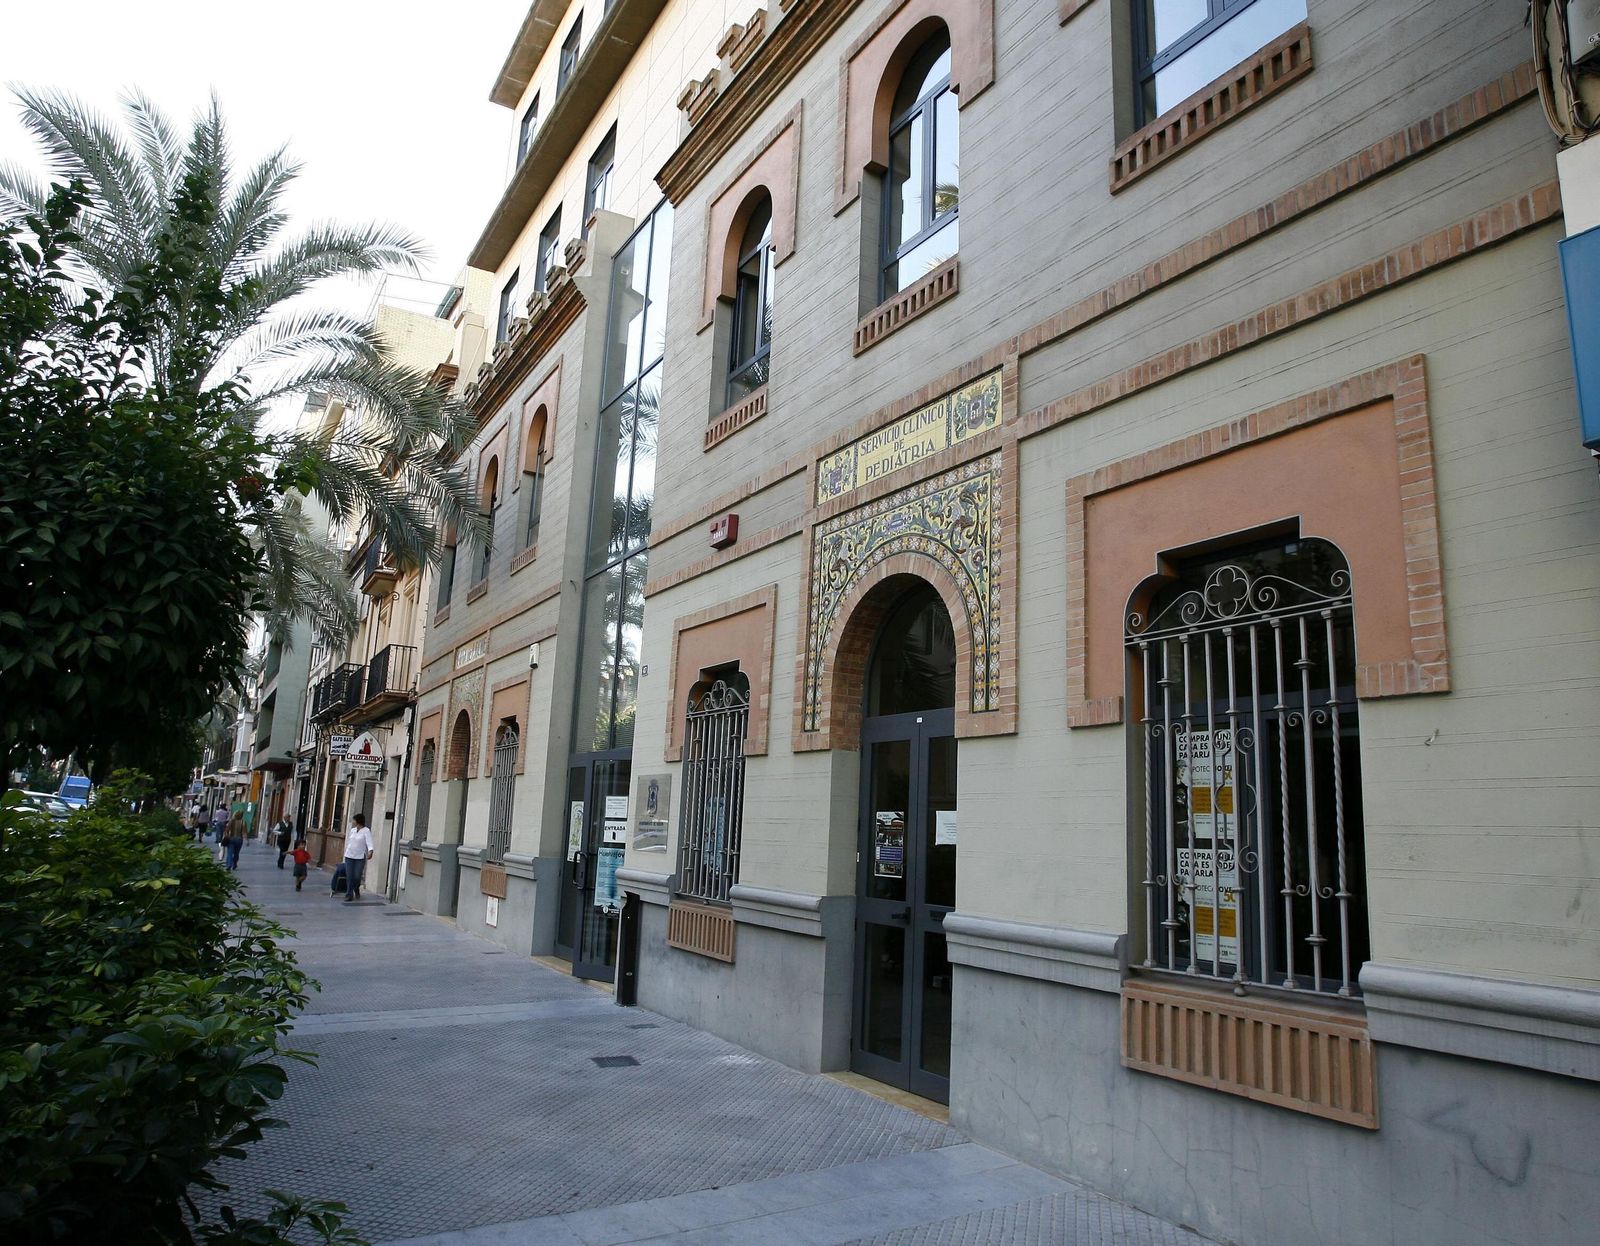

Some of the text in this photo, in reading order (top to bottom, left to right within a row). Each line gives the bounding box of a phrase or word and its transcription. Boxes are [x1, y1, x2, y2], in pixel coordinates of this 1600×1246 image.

[861, 403, 944, 456] SERVICIO CLINICO
[894, 438, 904, 452] DE
[866, 438, 935, 480] PEDIATRIA
[347, 752, 383, 763] Cruzcampo
[1180, 860, 1198, 868] CAA
[1180, 868, 1213, 877] PAARLA
